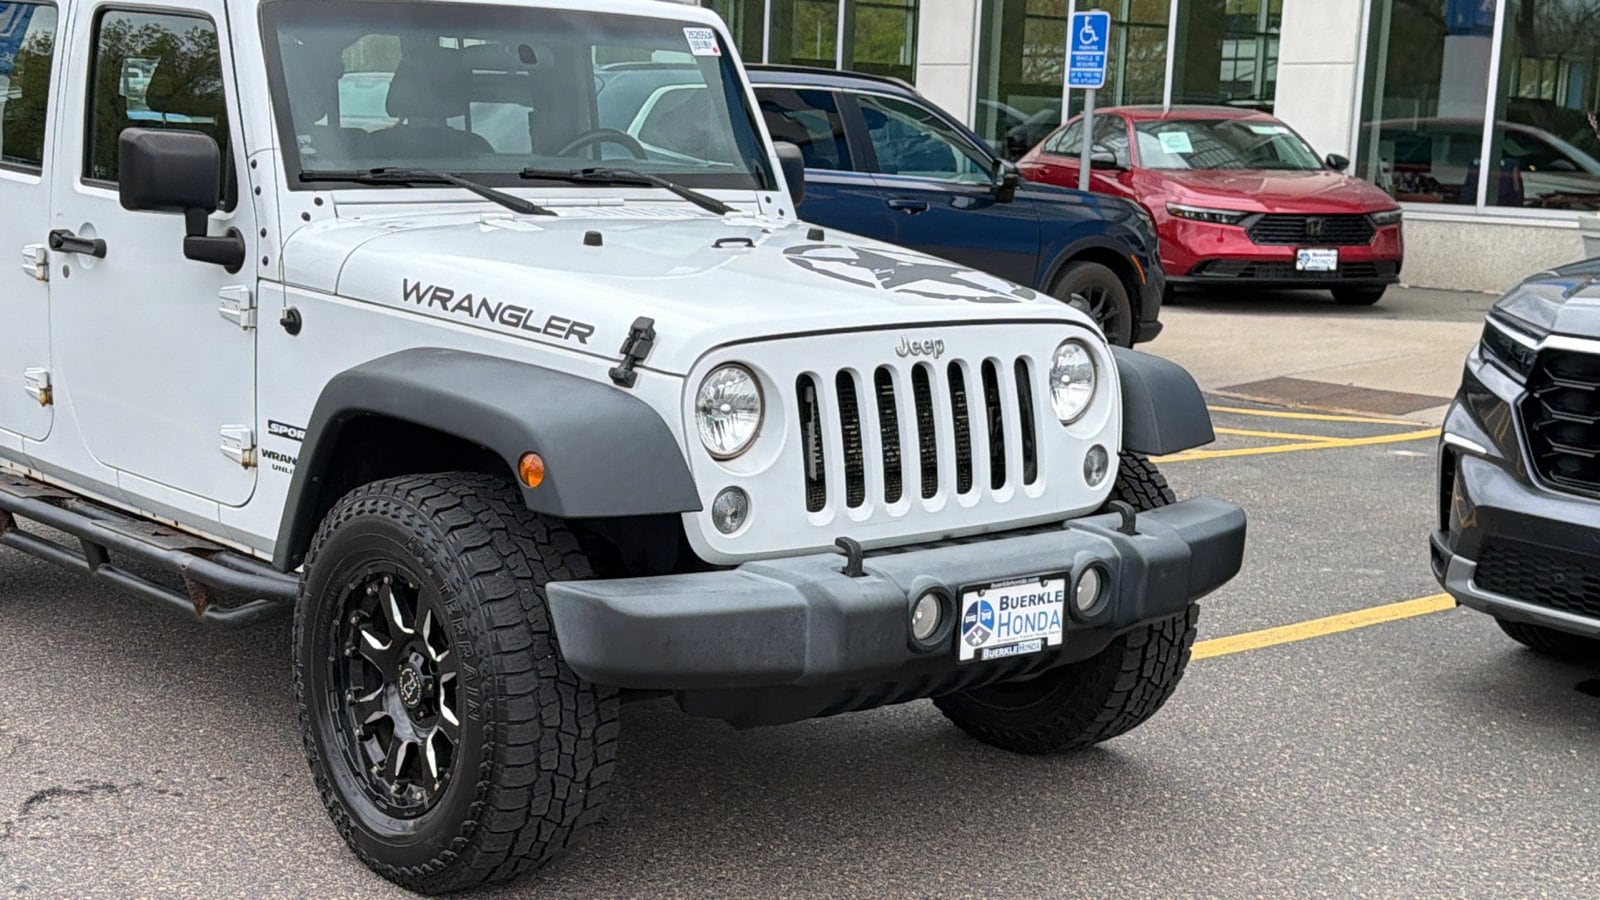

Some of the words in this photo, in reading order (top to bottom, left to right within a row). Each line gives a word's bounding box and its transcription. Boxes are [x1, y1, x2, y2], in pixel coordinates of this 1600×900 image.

[403, 278, 595, 345] WRANGLER
[895, 335, 945, 359] Jeep
[1000, 590, 1062, 611] BUERKLE
[997, 609, 1060, 637] HONDA
[439, 576, 480, 722] TERRAIN
